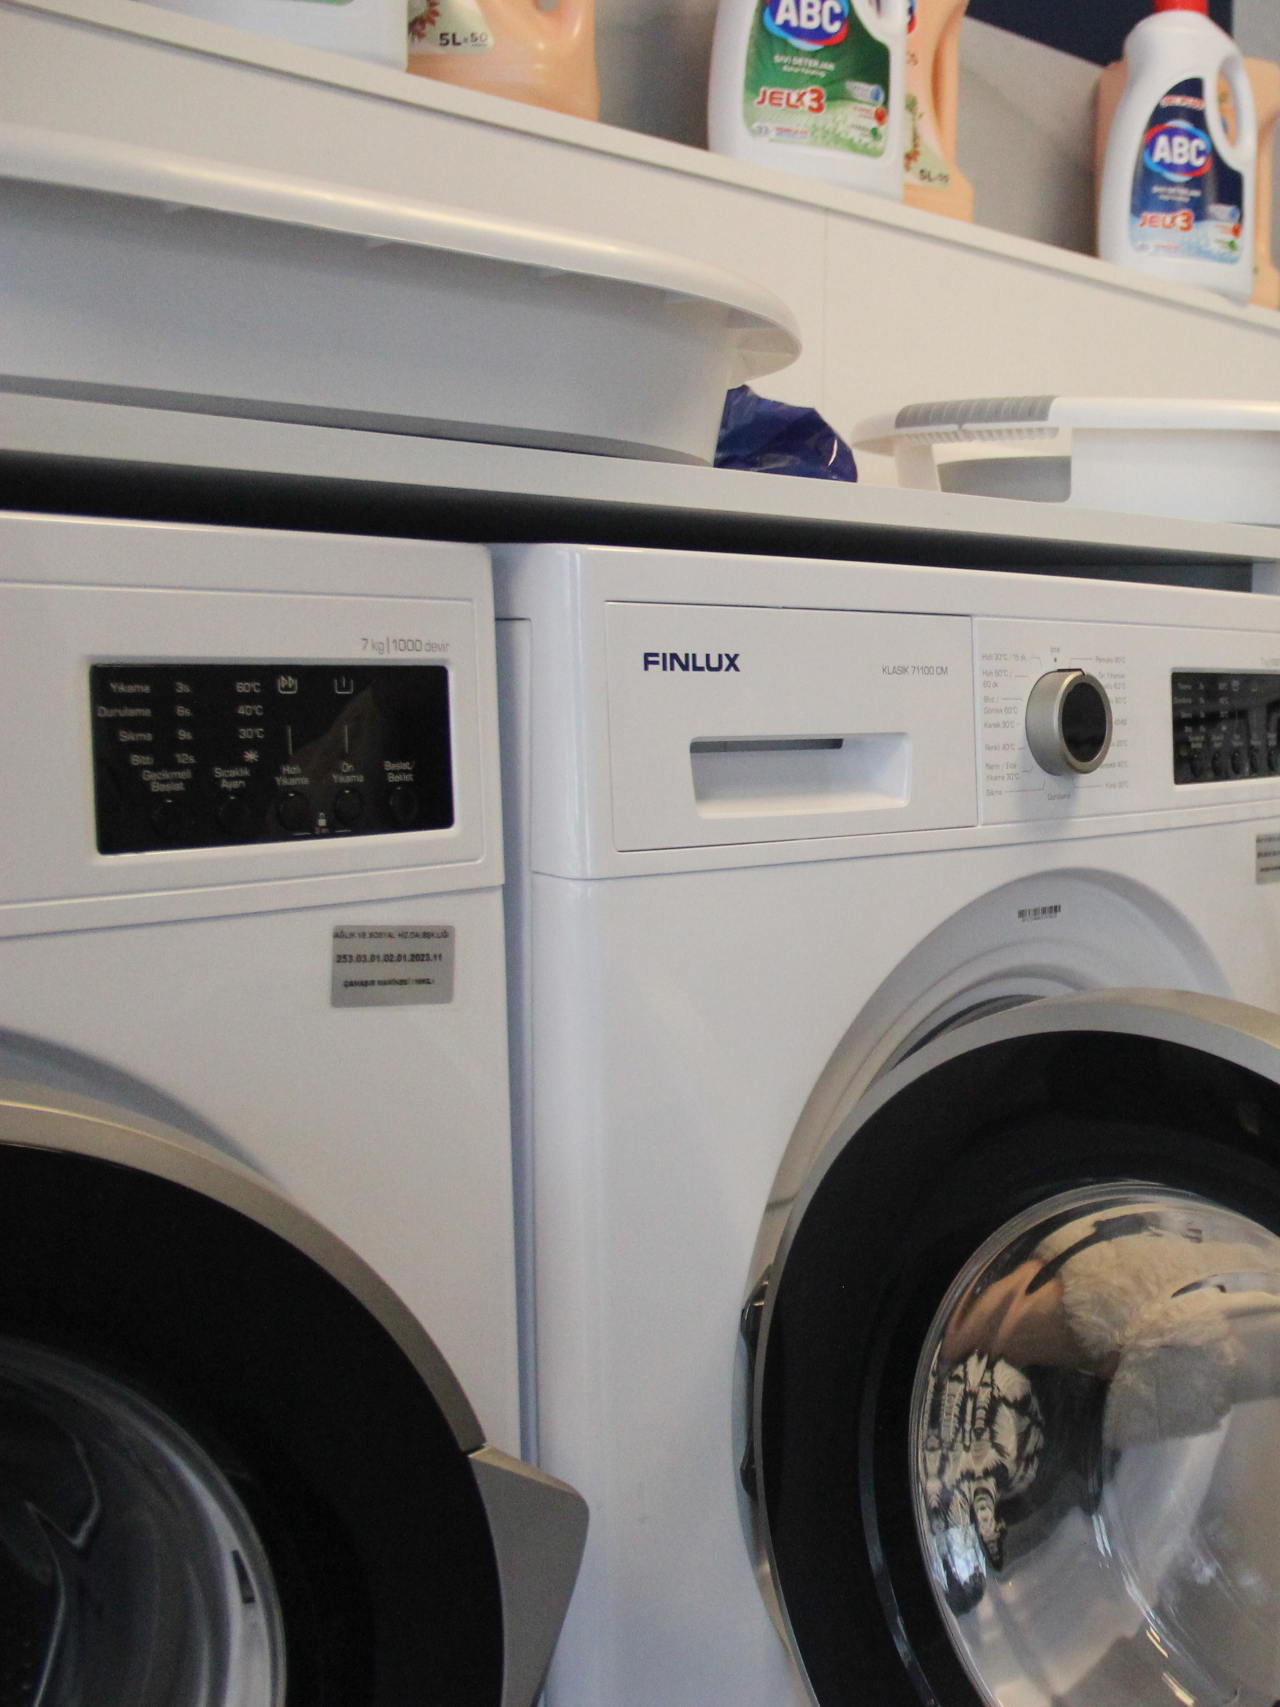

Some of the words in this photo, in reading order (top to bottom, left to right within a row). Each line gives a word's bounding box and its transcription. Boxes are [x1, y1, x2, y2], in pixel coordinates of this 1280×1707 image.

[775, 0, 842, 33] ABC
[1153, 134, 1206, 167] ABC
[643, 652, 740, 672] FINLUX
